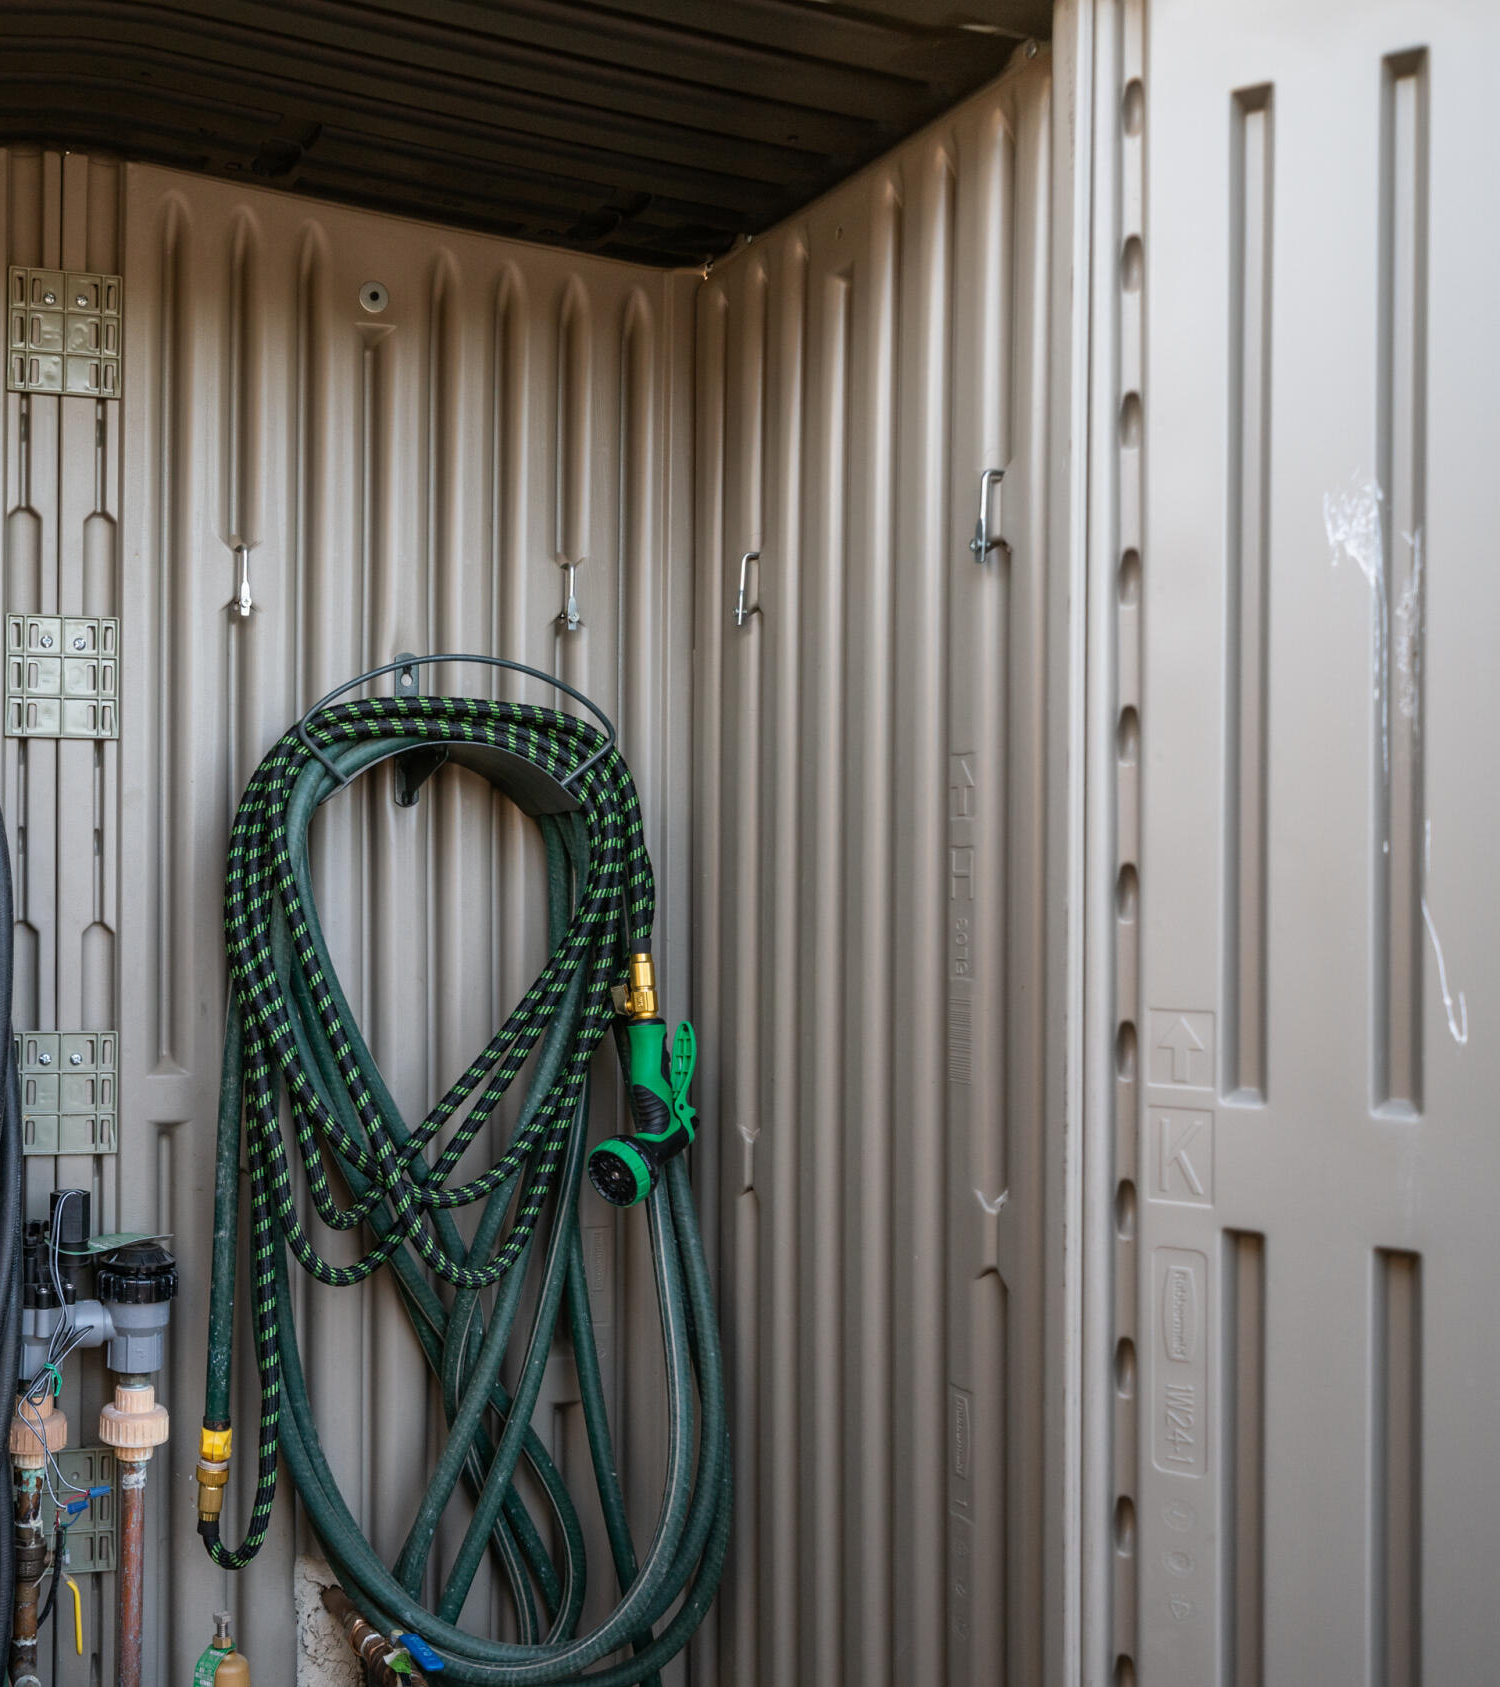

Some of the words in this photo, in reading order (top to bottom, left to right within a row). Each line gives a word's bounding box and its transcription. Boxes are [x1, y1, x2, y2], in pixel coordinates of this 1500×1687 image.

[950, 848, 976, 901] H
[1158, 1117, 1206, 1194] K
[1164, 1383, 1195, 1465] 1W24-1
